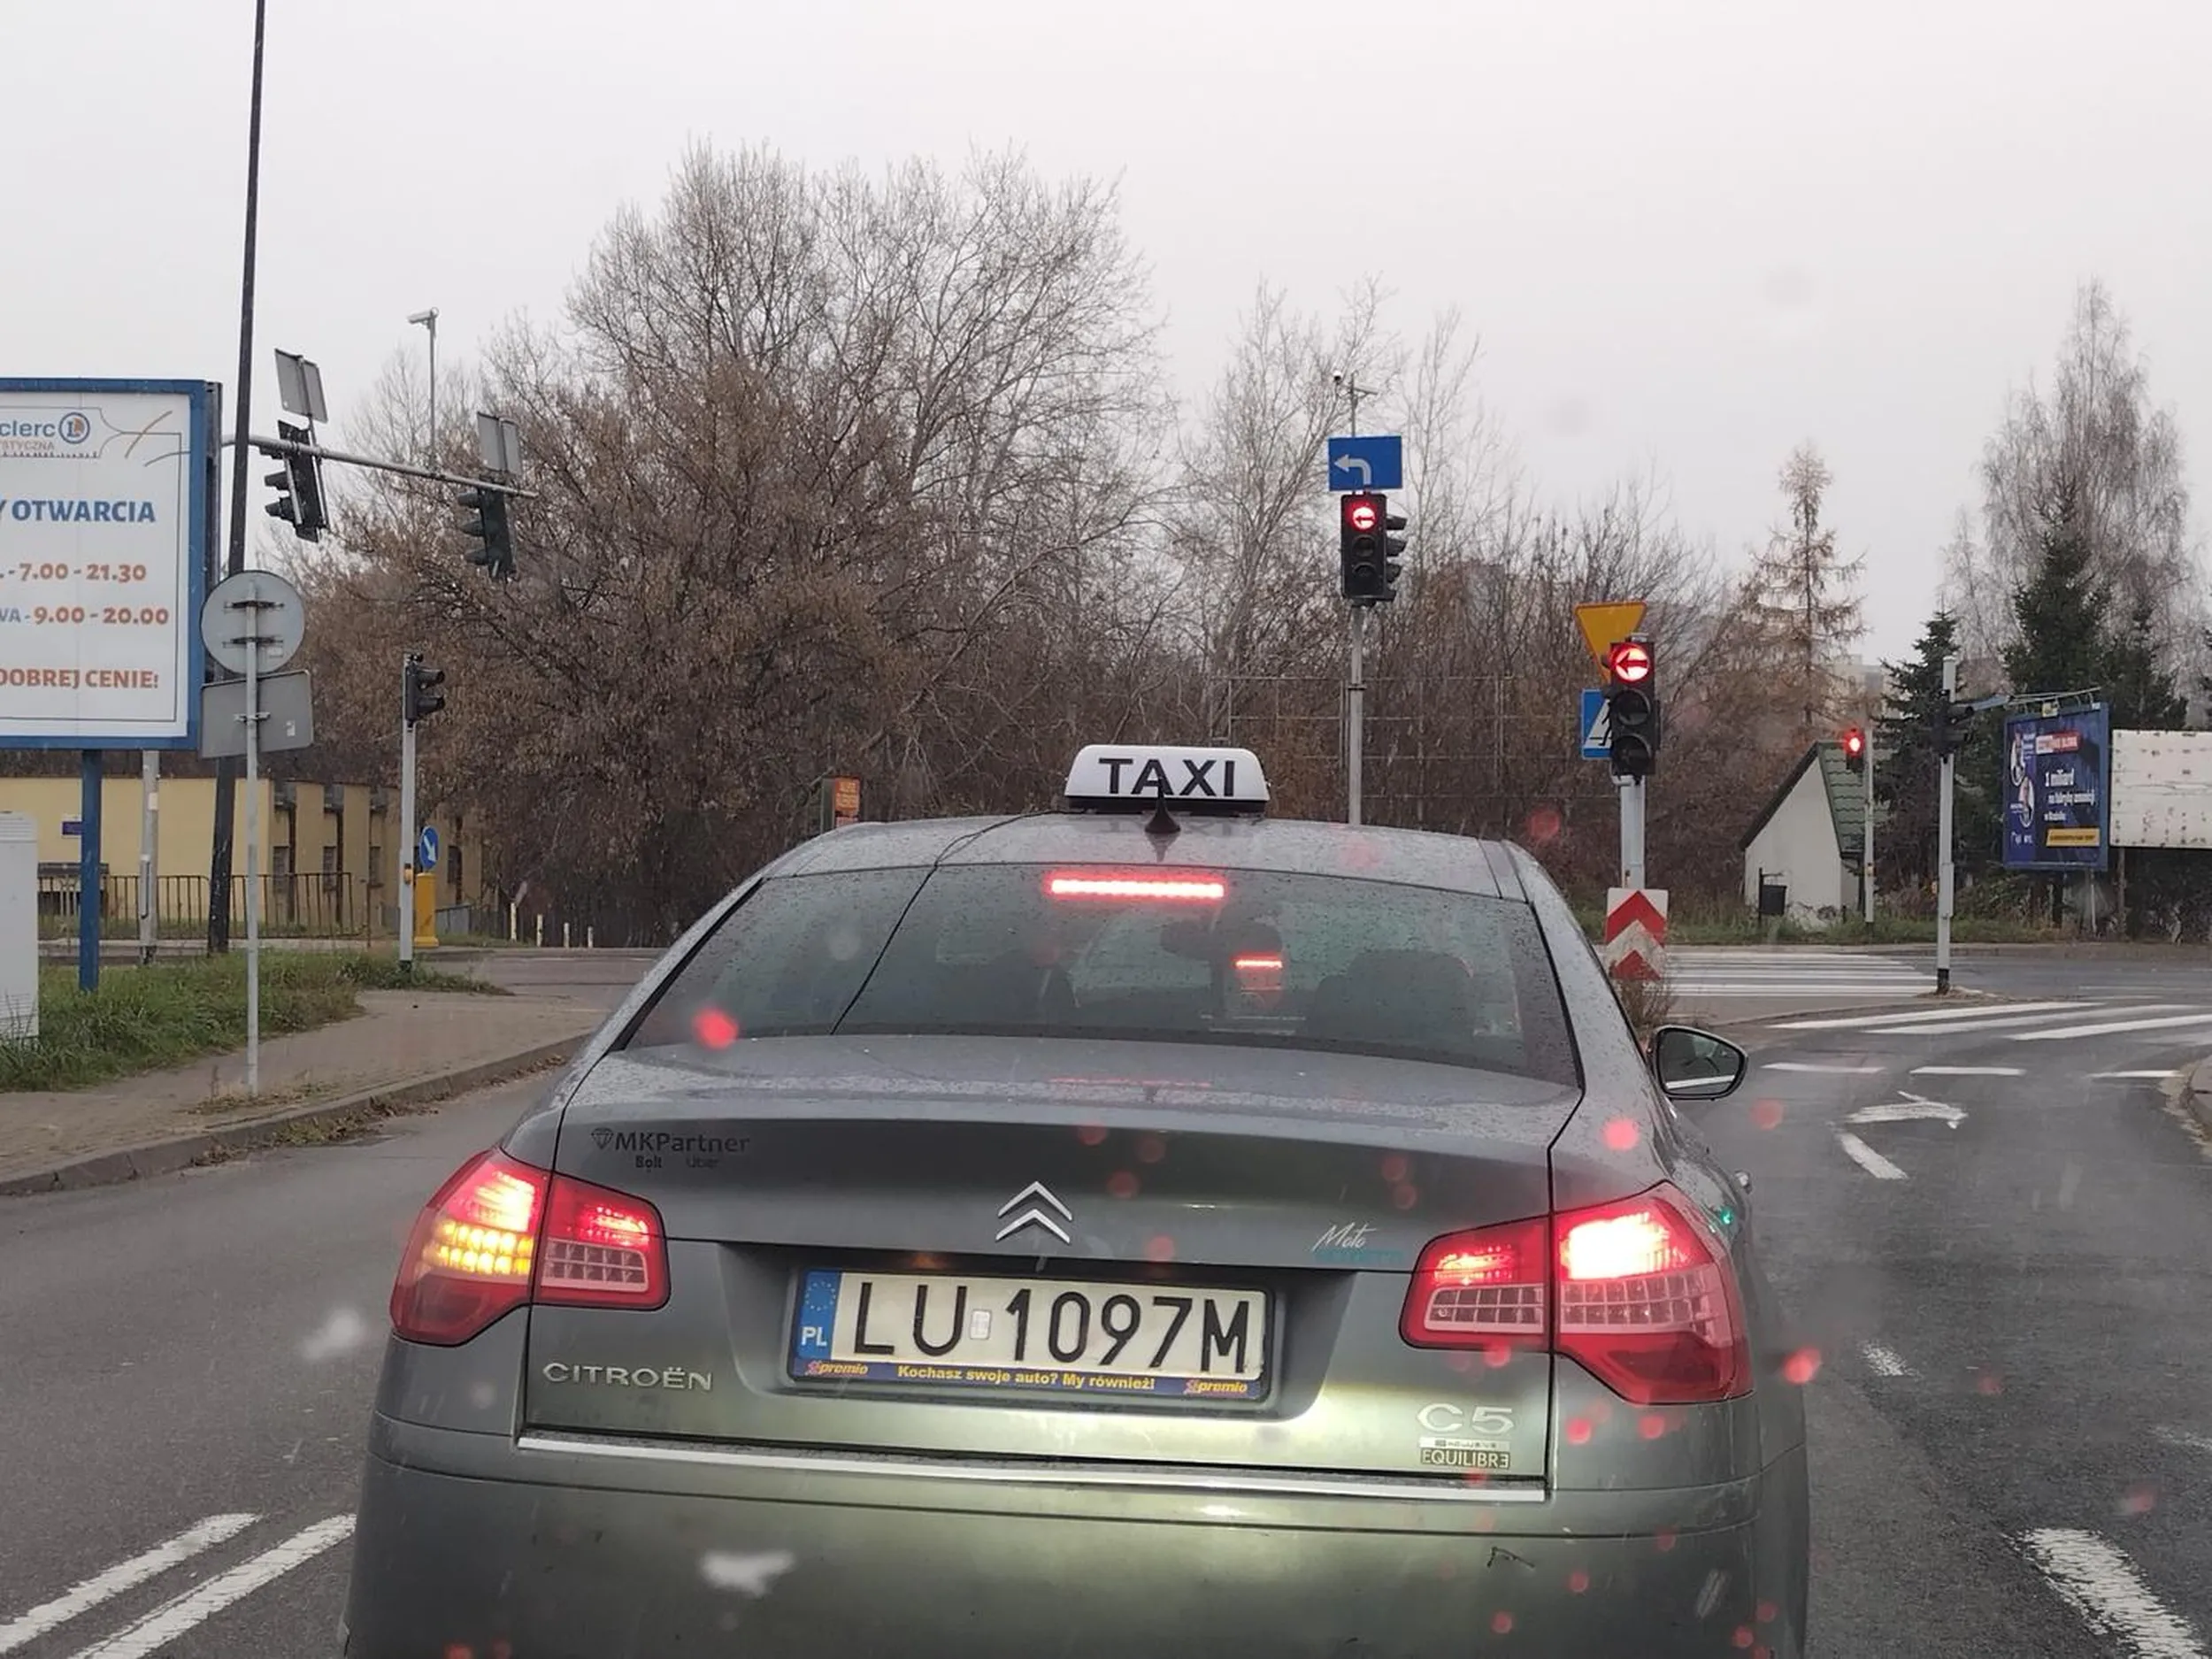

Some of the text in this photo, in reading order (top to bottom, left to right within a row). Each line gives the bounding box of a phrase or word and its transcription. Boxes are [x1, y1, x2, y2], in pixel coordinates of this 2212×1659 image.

[12, 500, 156, 522] OTWARCIA
[19, 563, 68, 581] 7.00
[86, 564, 147, 583] 21.30
[34, 606, 85, 625] 9.00
[103, 607, 169, 625] 20.00
[85, 670, 158, 688] CENIE!
[1098, 757, 1235, 797] TAXI
[615, 1131, 750, 1153] MKPartner
[634, 1156, 663, 1169] Bolt
[801, 1326, 828, 1347] PL
[853, 1281, 1249, 1374] LU 1097M
[542, 1363, 712, 1391] CITROËN
[818, 1364, 869, 1376] premio
[897, 1365, 1156, 1391] Kochasz swoje auto? My również!
[1199, 1381, 1248, 1394] premio
[1417, 1403, 1514, 1433] C5
